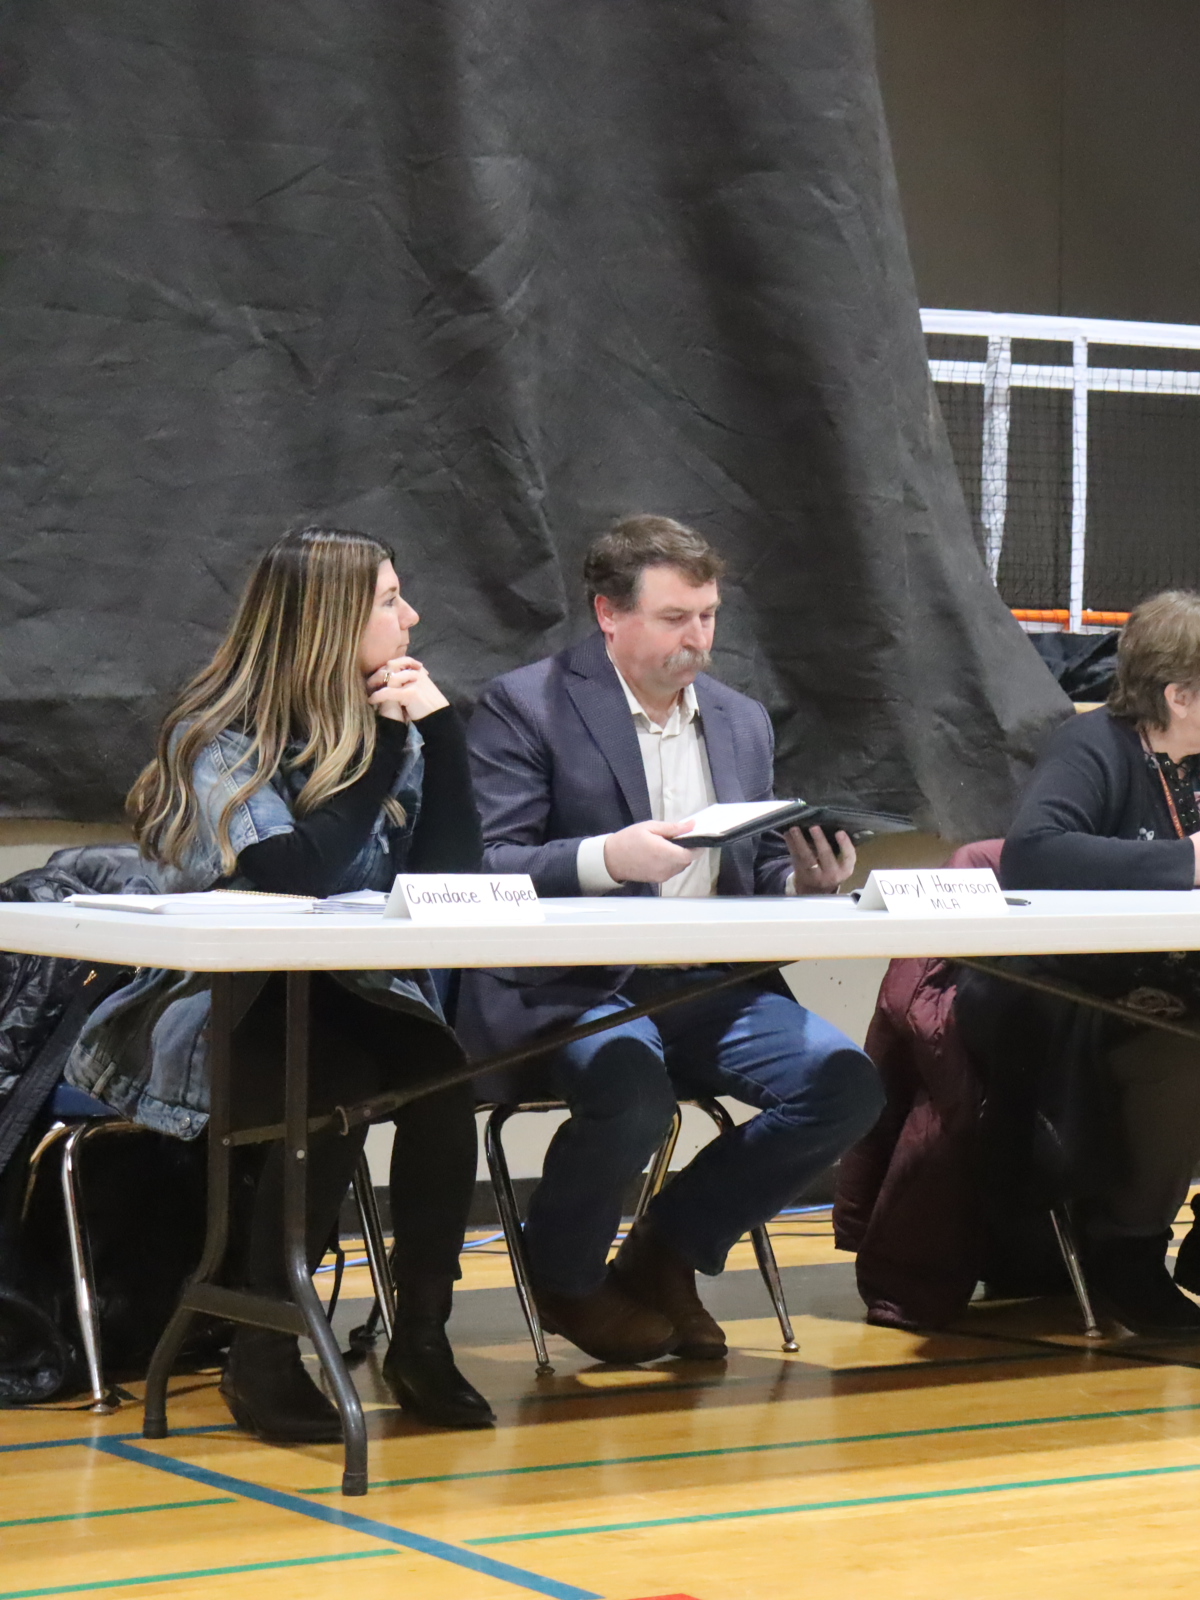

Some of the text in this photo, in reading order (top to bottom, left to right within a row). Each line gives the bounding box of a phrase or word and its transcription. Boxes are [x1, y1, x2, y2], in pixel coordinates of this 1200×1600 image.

[406, 881, 537, 907] Candace Kopec
[879, 874, 998, 898] Daryl Harrison
[930, 898, 961, 910] MLA
